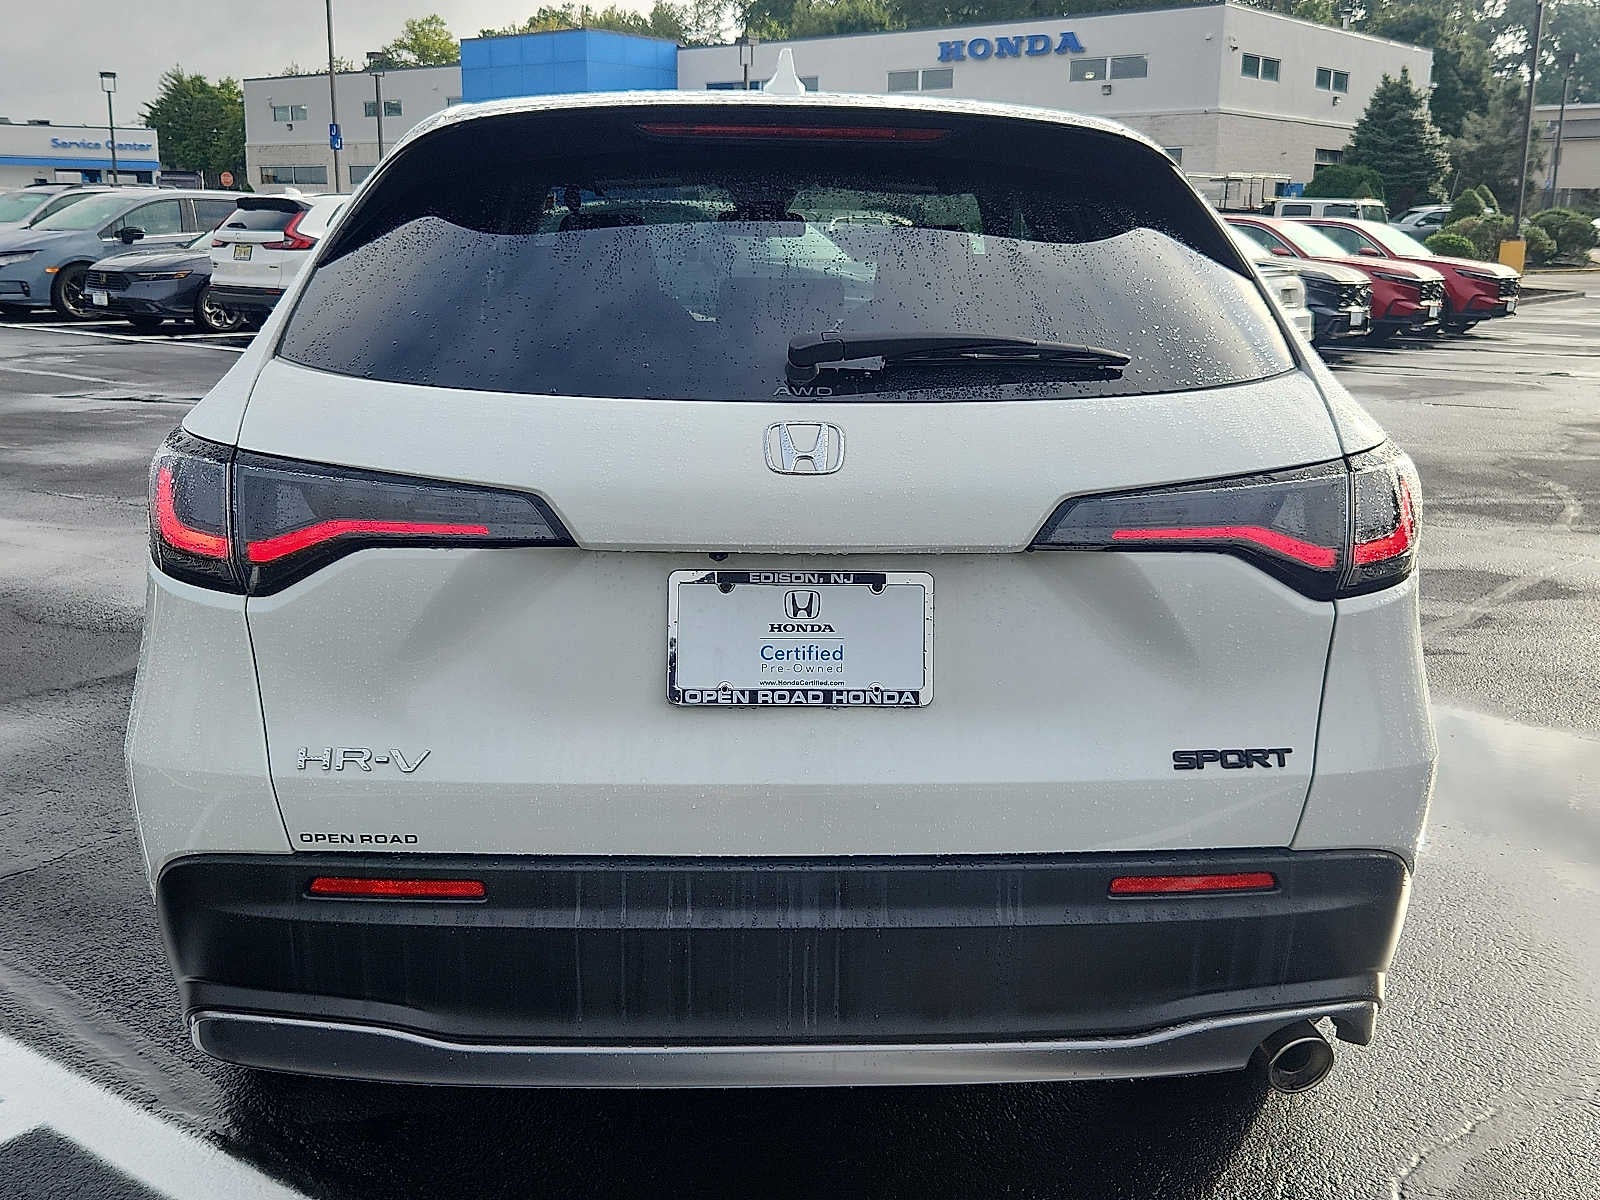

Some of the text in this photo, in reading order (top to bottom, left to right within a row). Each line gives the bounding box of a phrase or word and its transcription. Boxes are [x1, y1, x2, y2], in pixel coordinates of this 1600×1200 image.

[938, 32, 1085, 62] HONDA
[52, 137, 152, 151] Service Center
[773, 386, 833, 396] AWD
[830, 573, 854, 583] NJ
[768, 623, 836, 633] HONDA
[760, 644, 844, 661] Certified
[761, 663, 843, 673] Pre-Owned
[759, 679, 845, 687] www.HondaCertified.com
[684, 690, 917, 704] OPEN ROAD HONDA
[297, 747, 432, 773] HR-V
[1172, 748, 1293, 770] SPORT
[300, 833, 418, 844] OPEN ROAD
